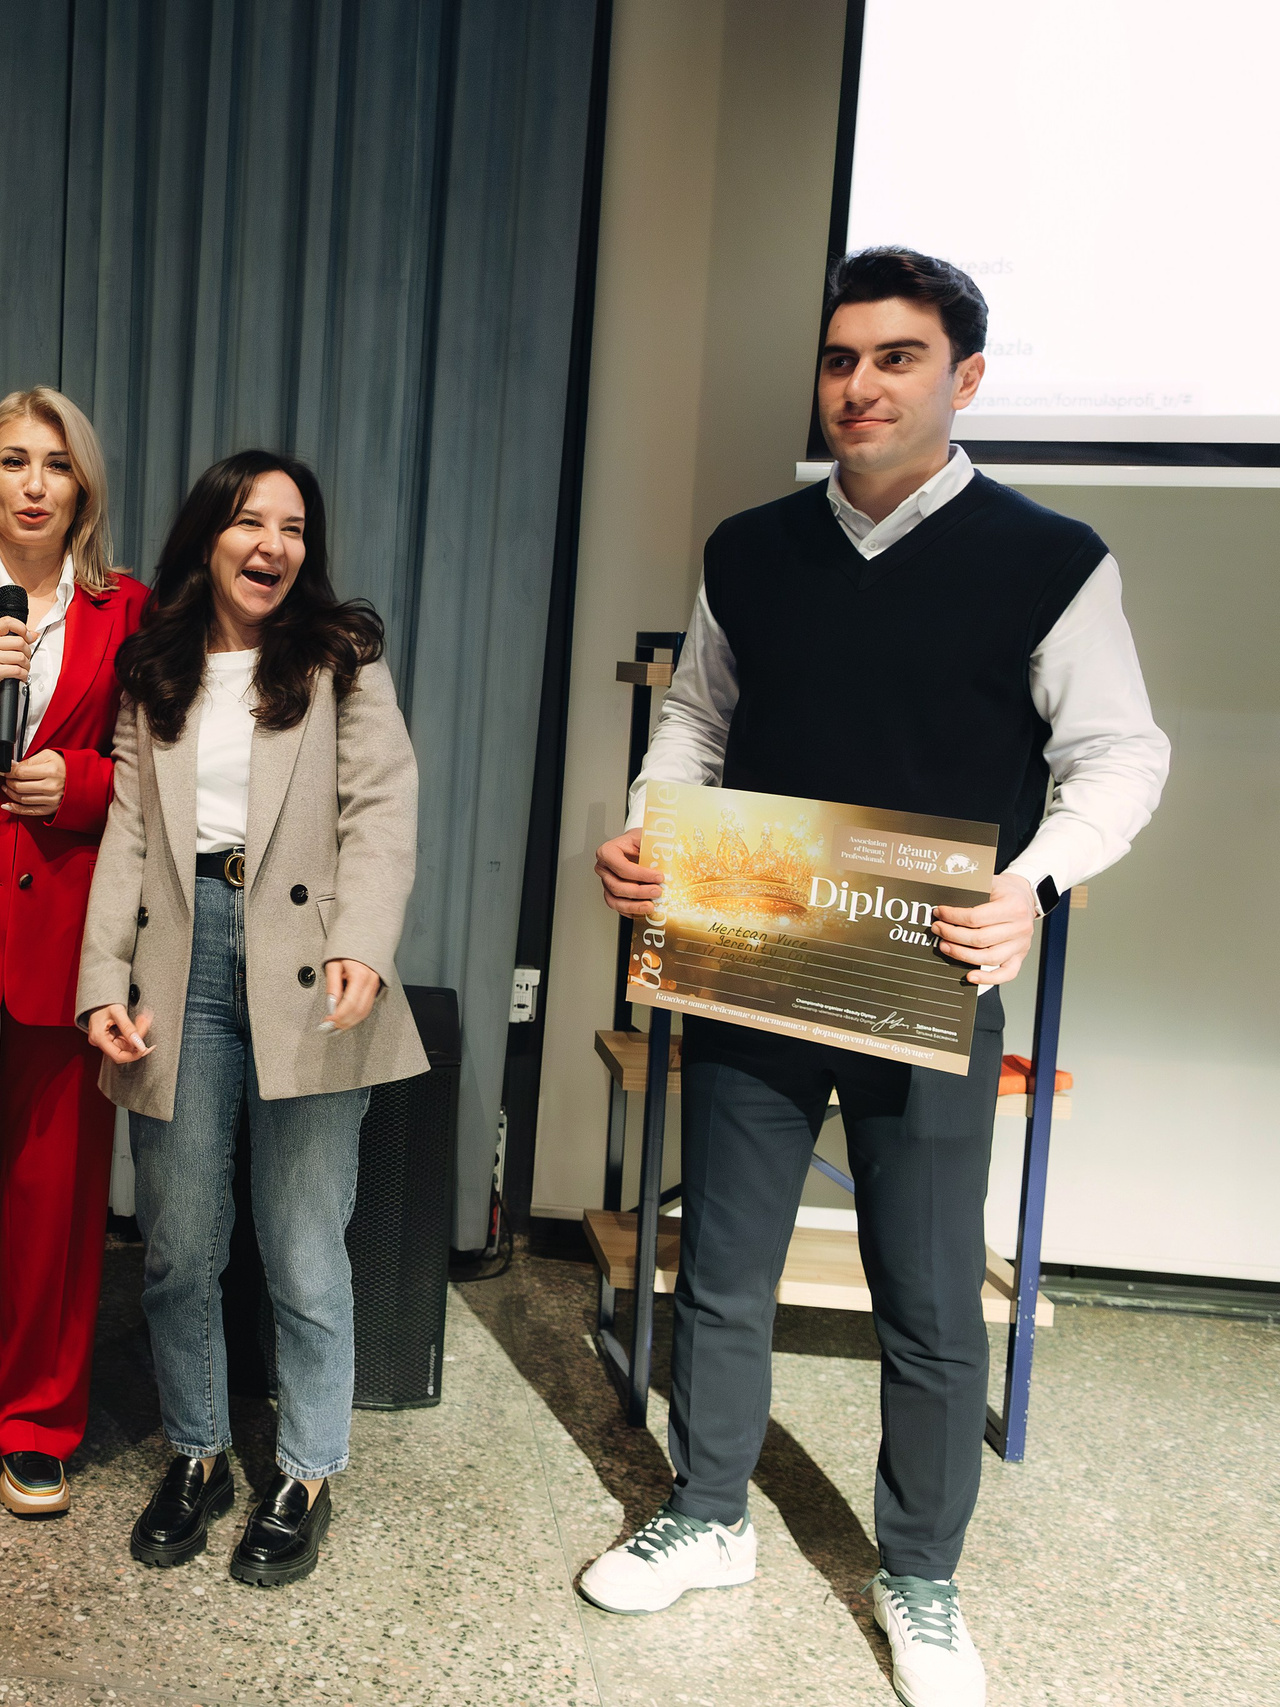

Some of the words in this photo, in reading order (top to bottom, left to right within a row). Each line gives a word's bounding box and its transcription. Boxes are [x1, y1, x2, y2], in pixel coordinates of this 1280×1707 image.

[849, 836, 887, 848] Association
[841, 851, 886, 864] Professionals
[862, 847, 887, 857] Beauty
[896, 856, 938, 874] olymp
[808, 876, 939, 928] Diplom
[707, 921, 768, 942] Mertcan
